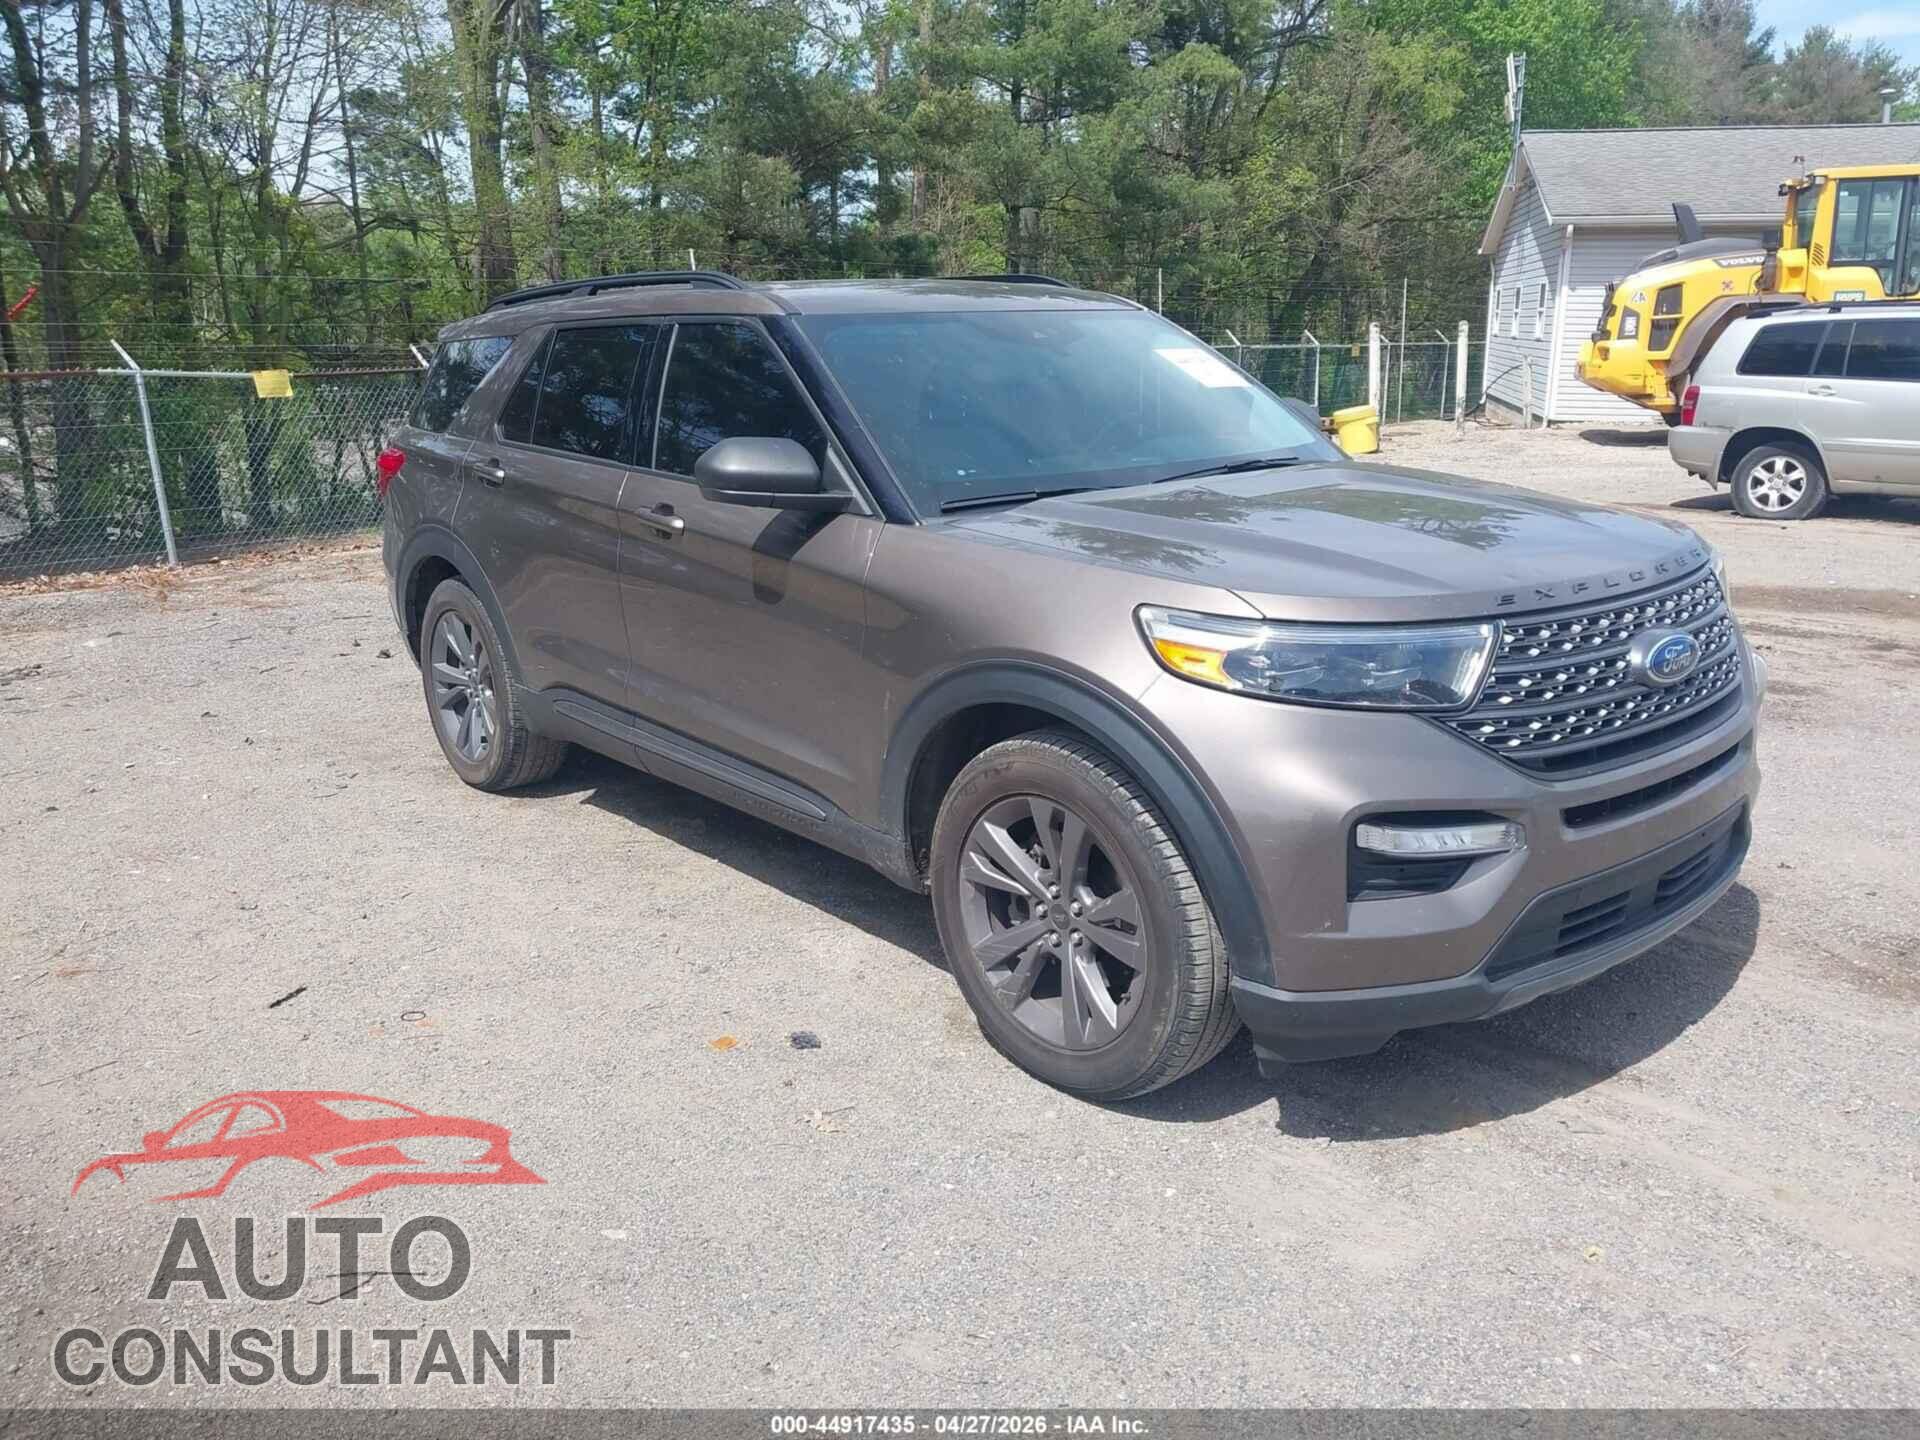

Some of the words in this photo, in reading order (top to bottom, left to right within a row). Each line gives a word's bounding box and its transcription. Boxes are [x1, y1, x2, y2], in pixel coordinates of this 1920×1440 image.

[1719, 256, 1765, 266] VOLVO
[1496, 548, 1702, 607] EXPLORER
[1663, 644, 1692, 673] Ford
